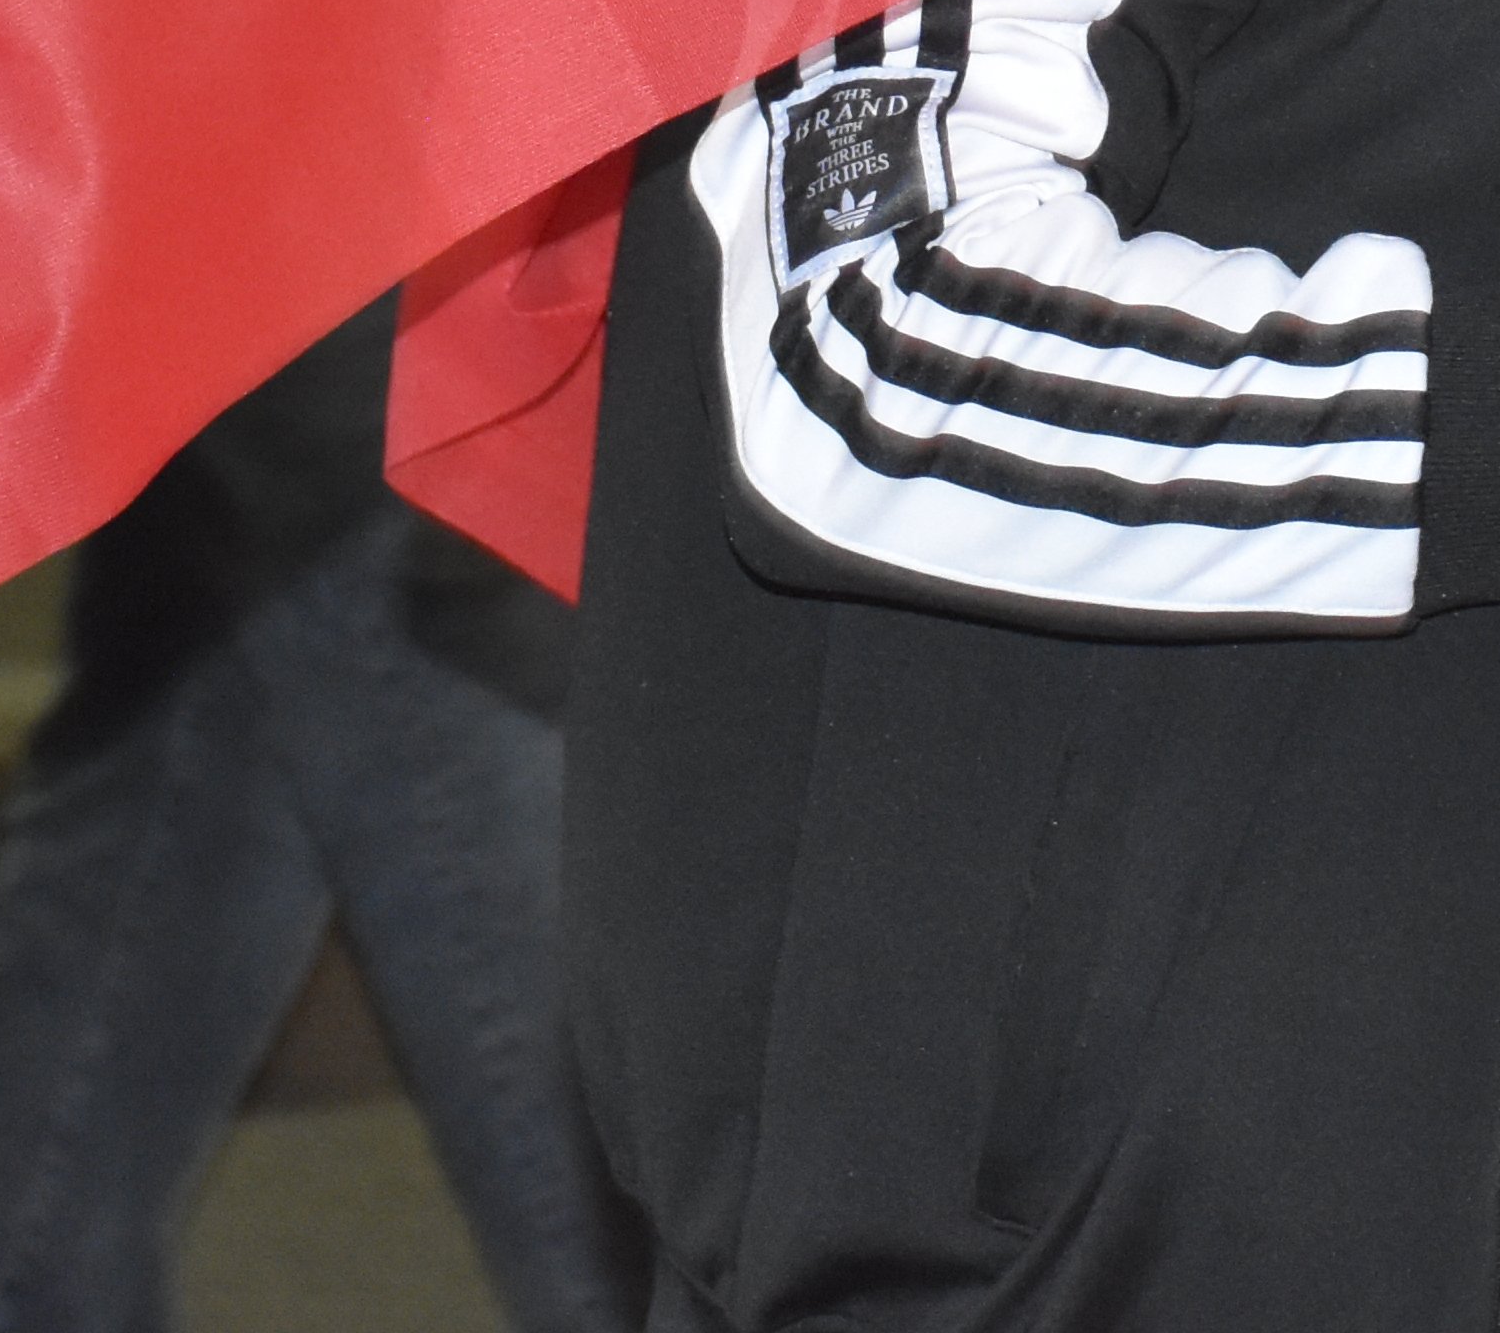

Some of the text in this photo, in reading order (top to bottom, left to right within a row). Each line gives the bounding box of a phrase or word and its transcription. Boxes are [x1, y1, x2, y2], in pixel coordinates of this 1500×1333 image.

[832, 88, 872, 103] THE
[794, 95, 909, 144] BRAND
[826, 120, 864, 139] WITH
[829, 134, 858, 151] THE
[817, 139, 876, 174] THREE
[806, 153, 891, 199] STRIPES
